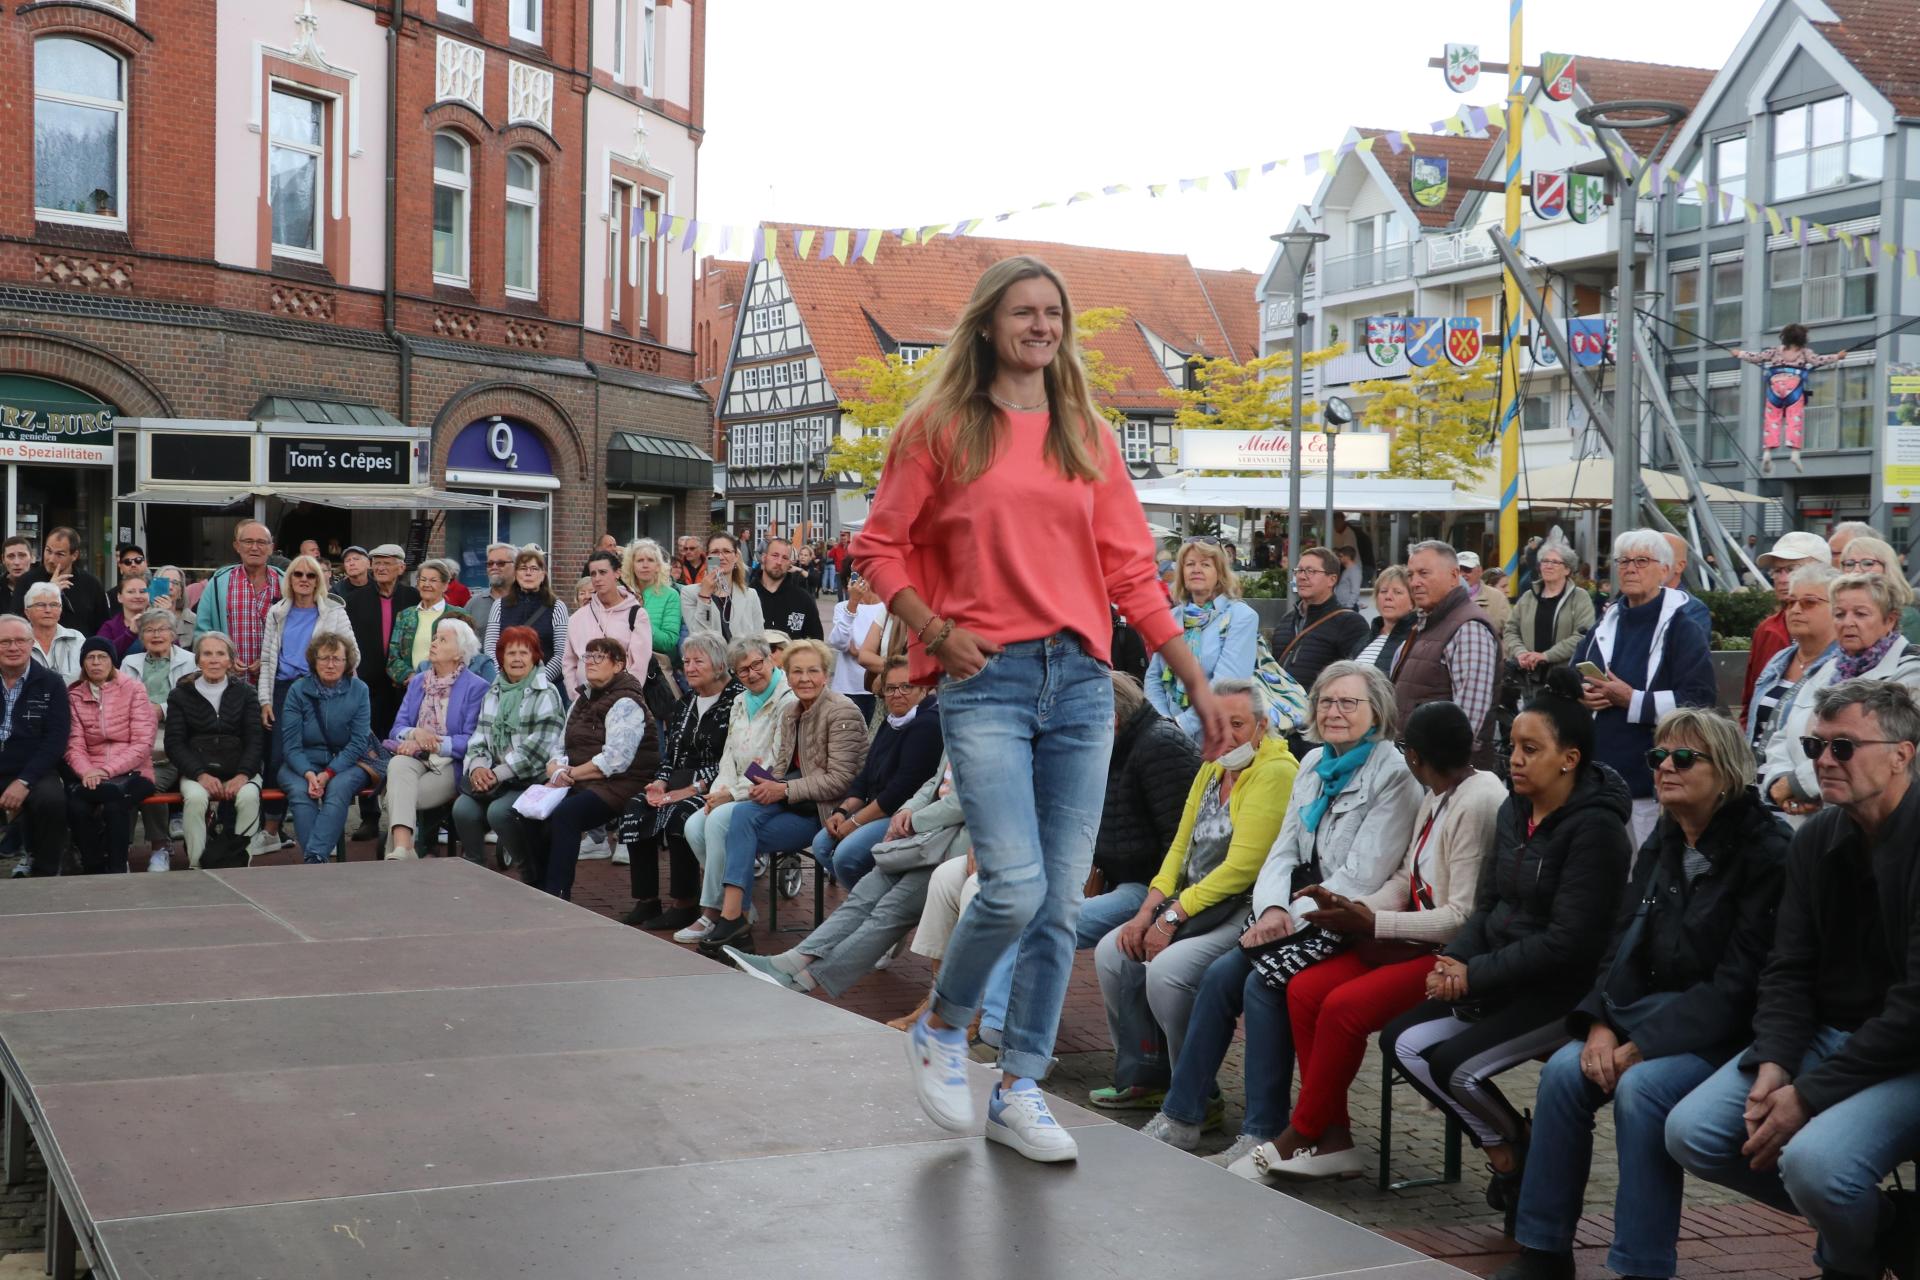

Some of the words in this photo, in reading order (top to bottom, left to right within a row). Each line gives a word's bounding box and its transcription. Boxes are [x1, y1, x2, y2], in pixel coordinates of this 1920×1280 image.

[0, 405, 112, 435] RZ-BURG
[20, 432, 57, 442] genießen
[19, 444, 103, 461] Spezialitäten
[340, 452, 392, 472] Crêpes
